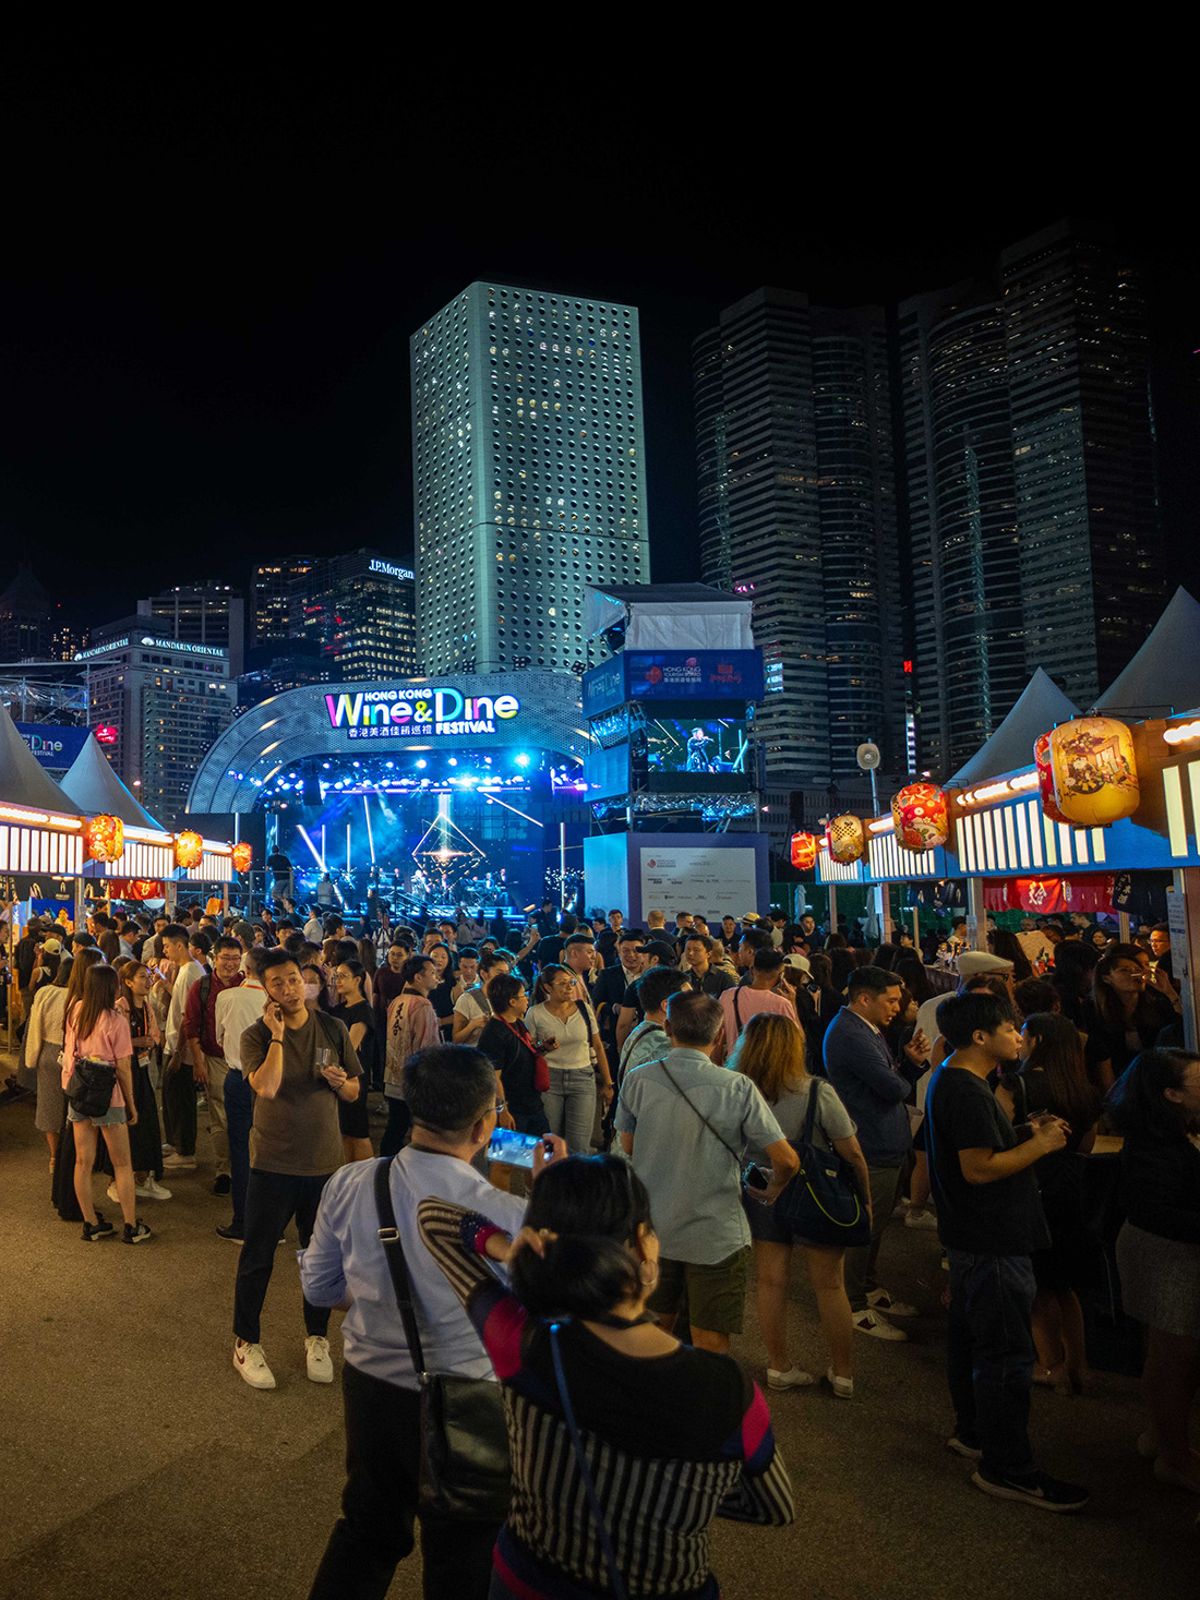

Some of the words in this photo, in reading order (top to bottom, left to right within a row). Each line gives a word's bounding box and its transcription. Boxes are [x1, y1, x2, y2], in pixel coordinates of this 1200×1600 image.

[155, 640, 191, 653] MANDARIN
[192, 645, 225, 658] ORIENTAL
[364, 690, 398, 702] HONG
[398, 688, 433, 700] KONG
[436, 720, 497, 735] FESTIVAL
